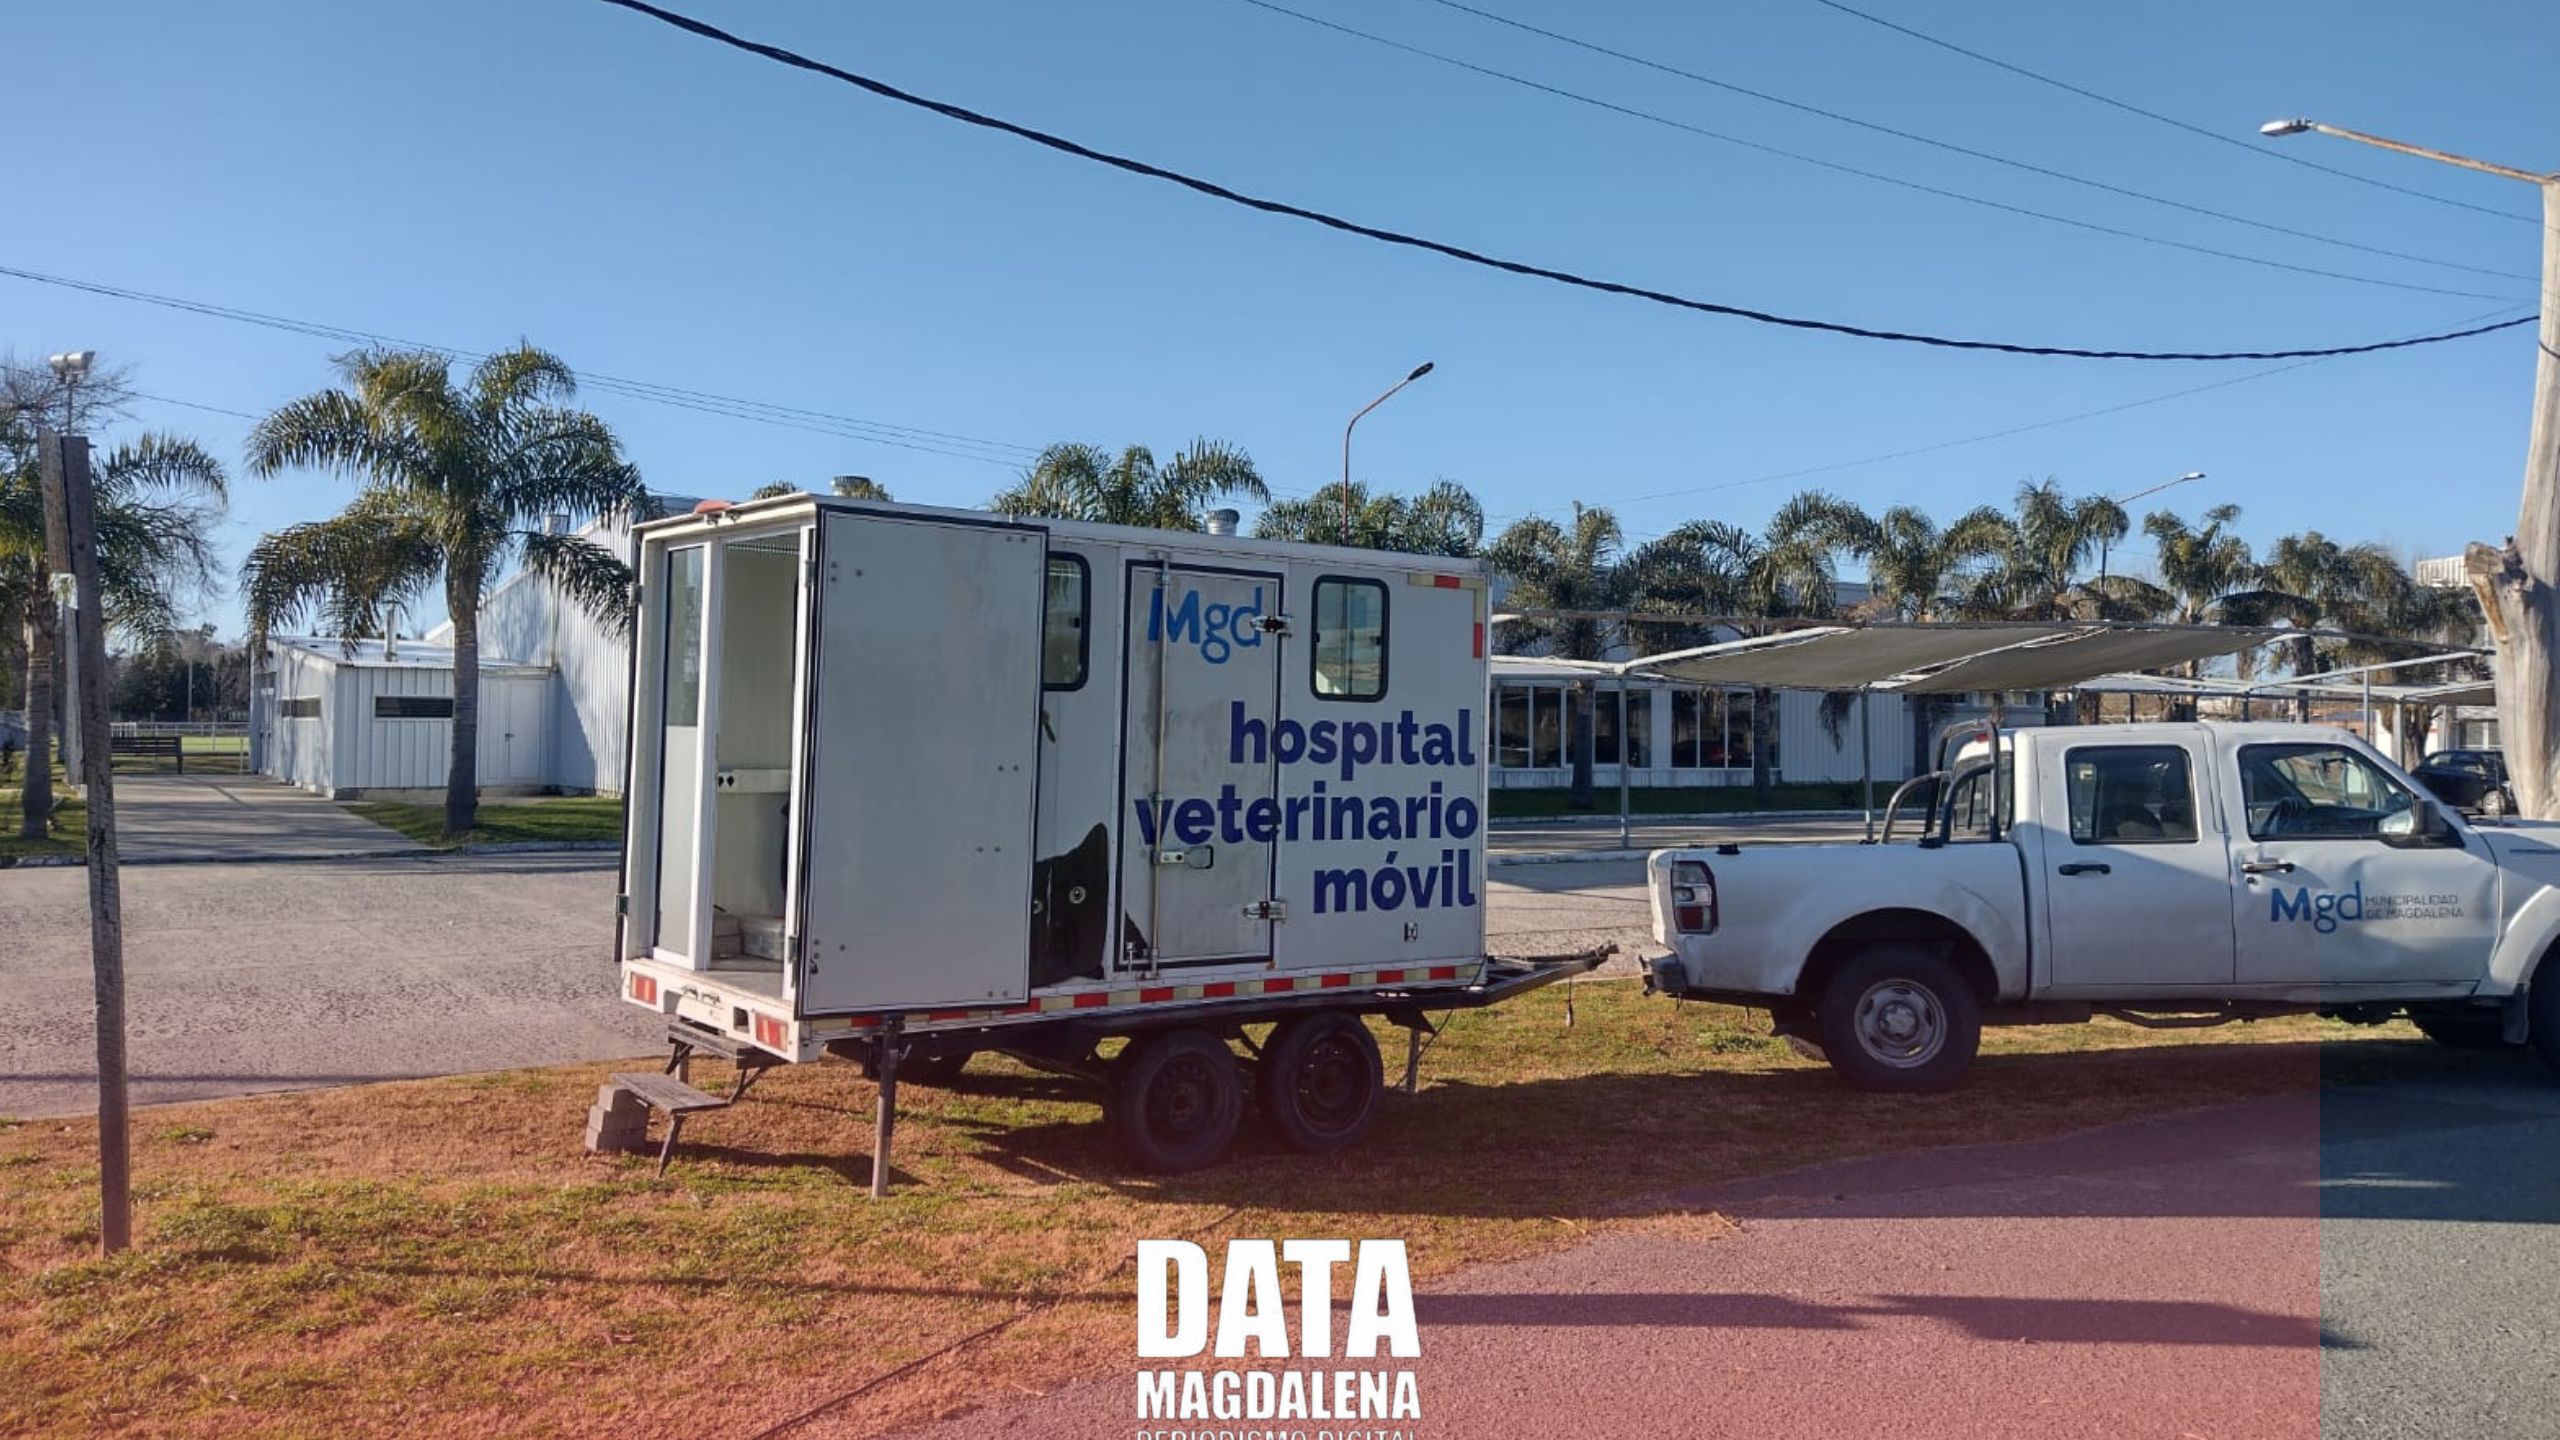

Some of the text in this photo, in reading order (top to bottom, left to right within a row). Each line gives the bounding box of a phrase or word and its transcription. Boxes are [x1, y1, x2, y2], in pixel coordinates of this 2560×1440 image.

[1147, 586, 1262, 664] Mgd
[1134, 780, 1478, 845] veterinario
[1313, 848, 1476, 913] móvil
[2270, 880, 2362, 934] Mgd
[2365, 894, 2458, 906] MUNICIPALIDAD
[2387, 907, 2464, 919] MAGDALENA
